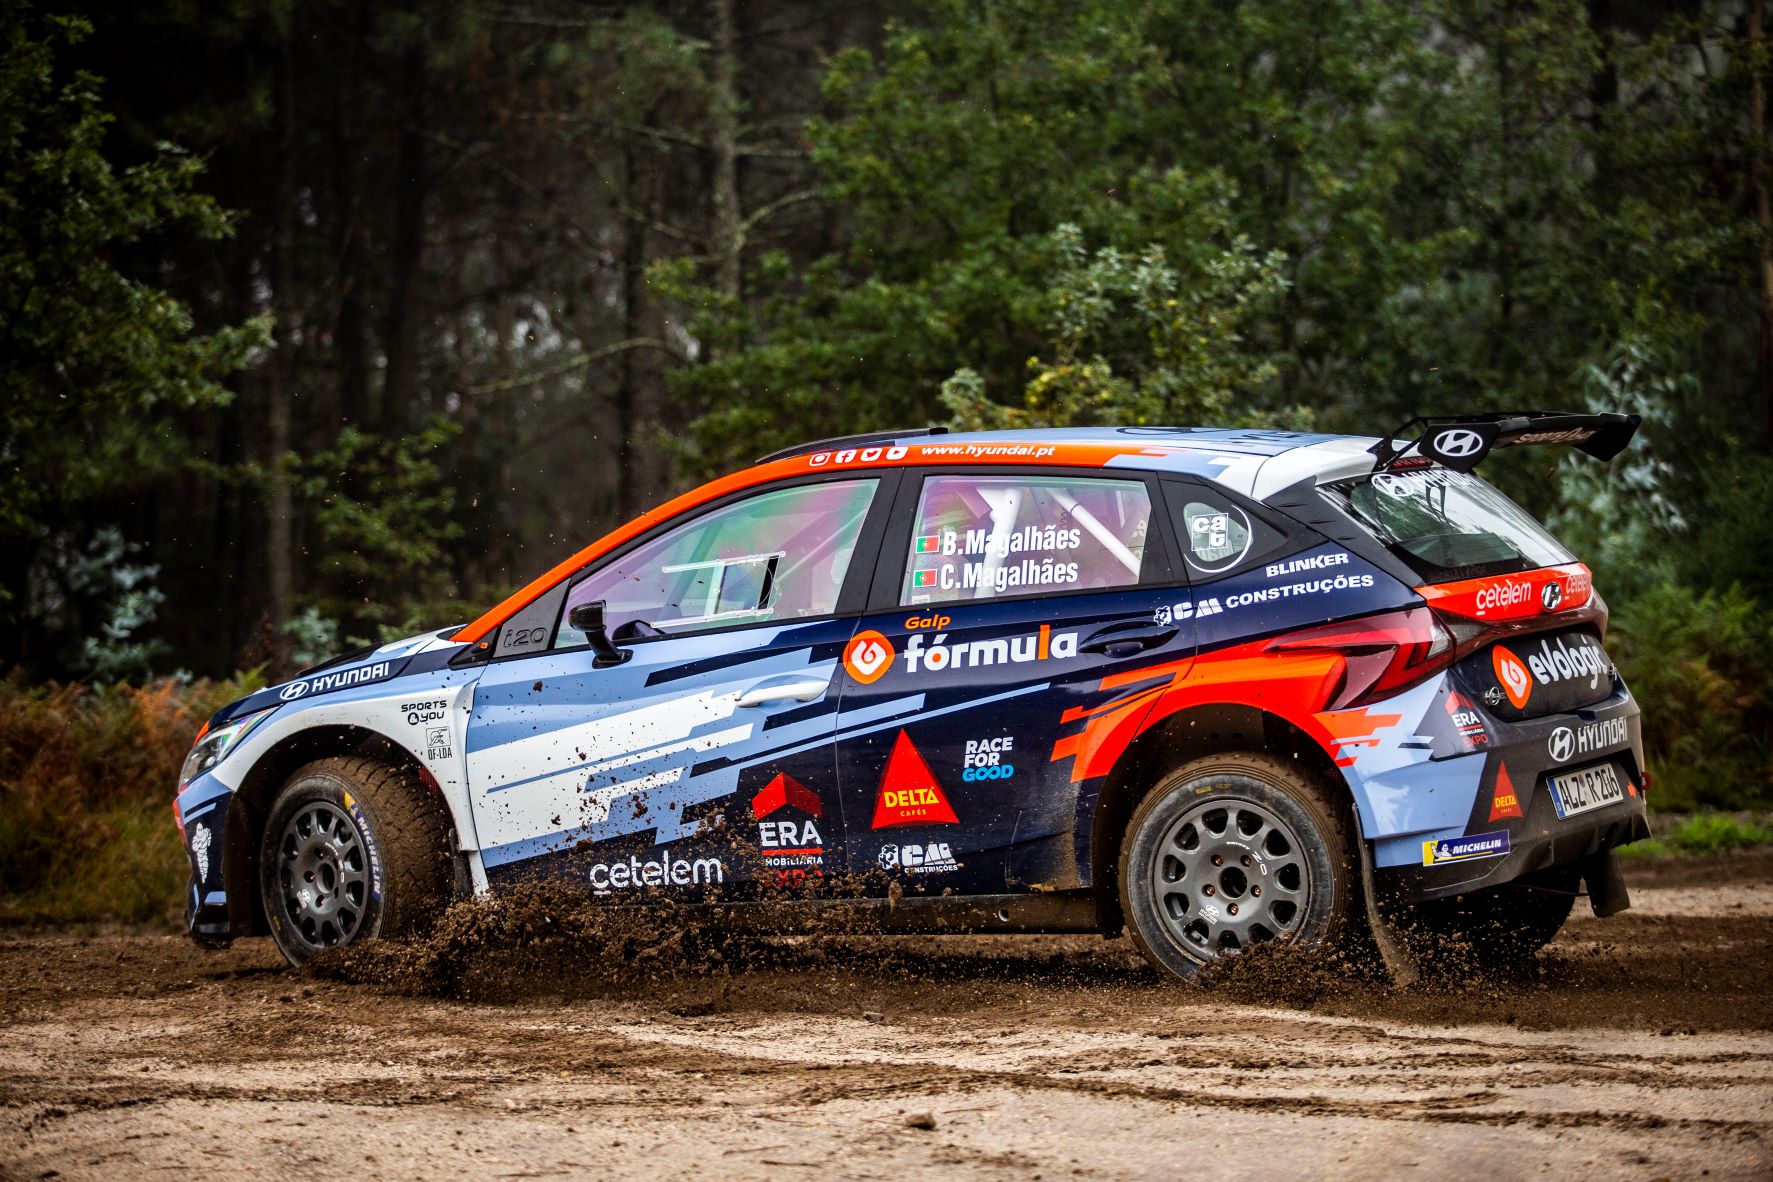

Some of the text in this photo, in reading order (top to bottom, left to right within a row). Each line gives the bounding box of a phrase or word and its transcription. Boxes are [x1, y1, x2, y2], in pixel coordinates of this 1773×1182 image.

[921, 444, 1055, 459] www.hyundai.pt
[1265, 553, 1349, 578] BLINKER
[1225, 574, 1375, 609] CONSTRUÇÕES
[1476, 579, 1531, 610] cetelem
[904, 614, 951, 631] Galp
[503, 627, 547, 648] i20
[903, 624, 1078, 673] fórmula
[311, 662, 390, 692] HYUNDAI
[401, 700, 447, 713] SPORTS
[1451, 711, 1480, 727] ERA
[1577, 715, 1628, 753] HYUNDAI
[965, 737, 1014, 754] RACE
[964, 752, 1001, 768] FOR
[962, 764, 1014, 782] GOOD
[884, 788, 940, 808] DELTA
[1558, 776, 1587, 811] ALZ
[1585, 773, 1600, 802] R
[1594, 767, 1620, 800] 206
[1495, 795, 1517, 808] DELTA
[900, 808, 927, 817] CAFÉS
[759, 820, 823, 847] ERA
[357, 816, 381, 894] MICHELIN
[1452, 838, 1502, 855] MICHELIN
[589, 850, 723, 889] cetelem
